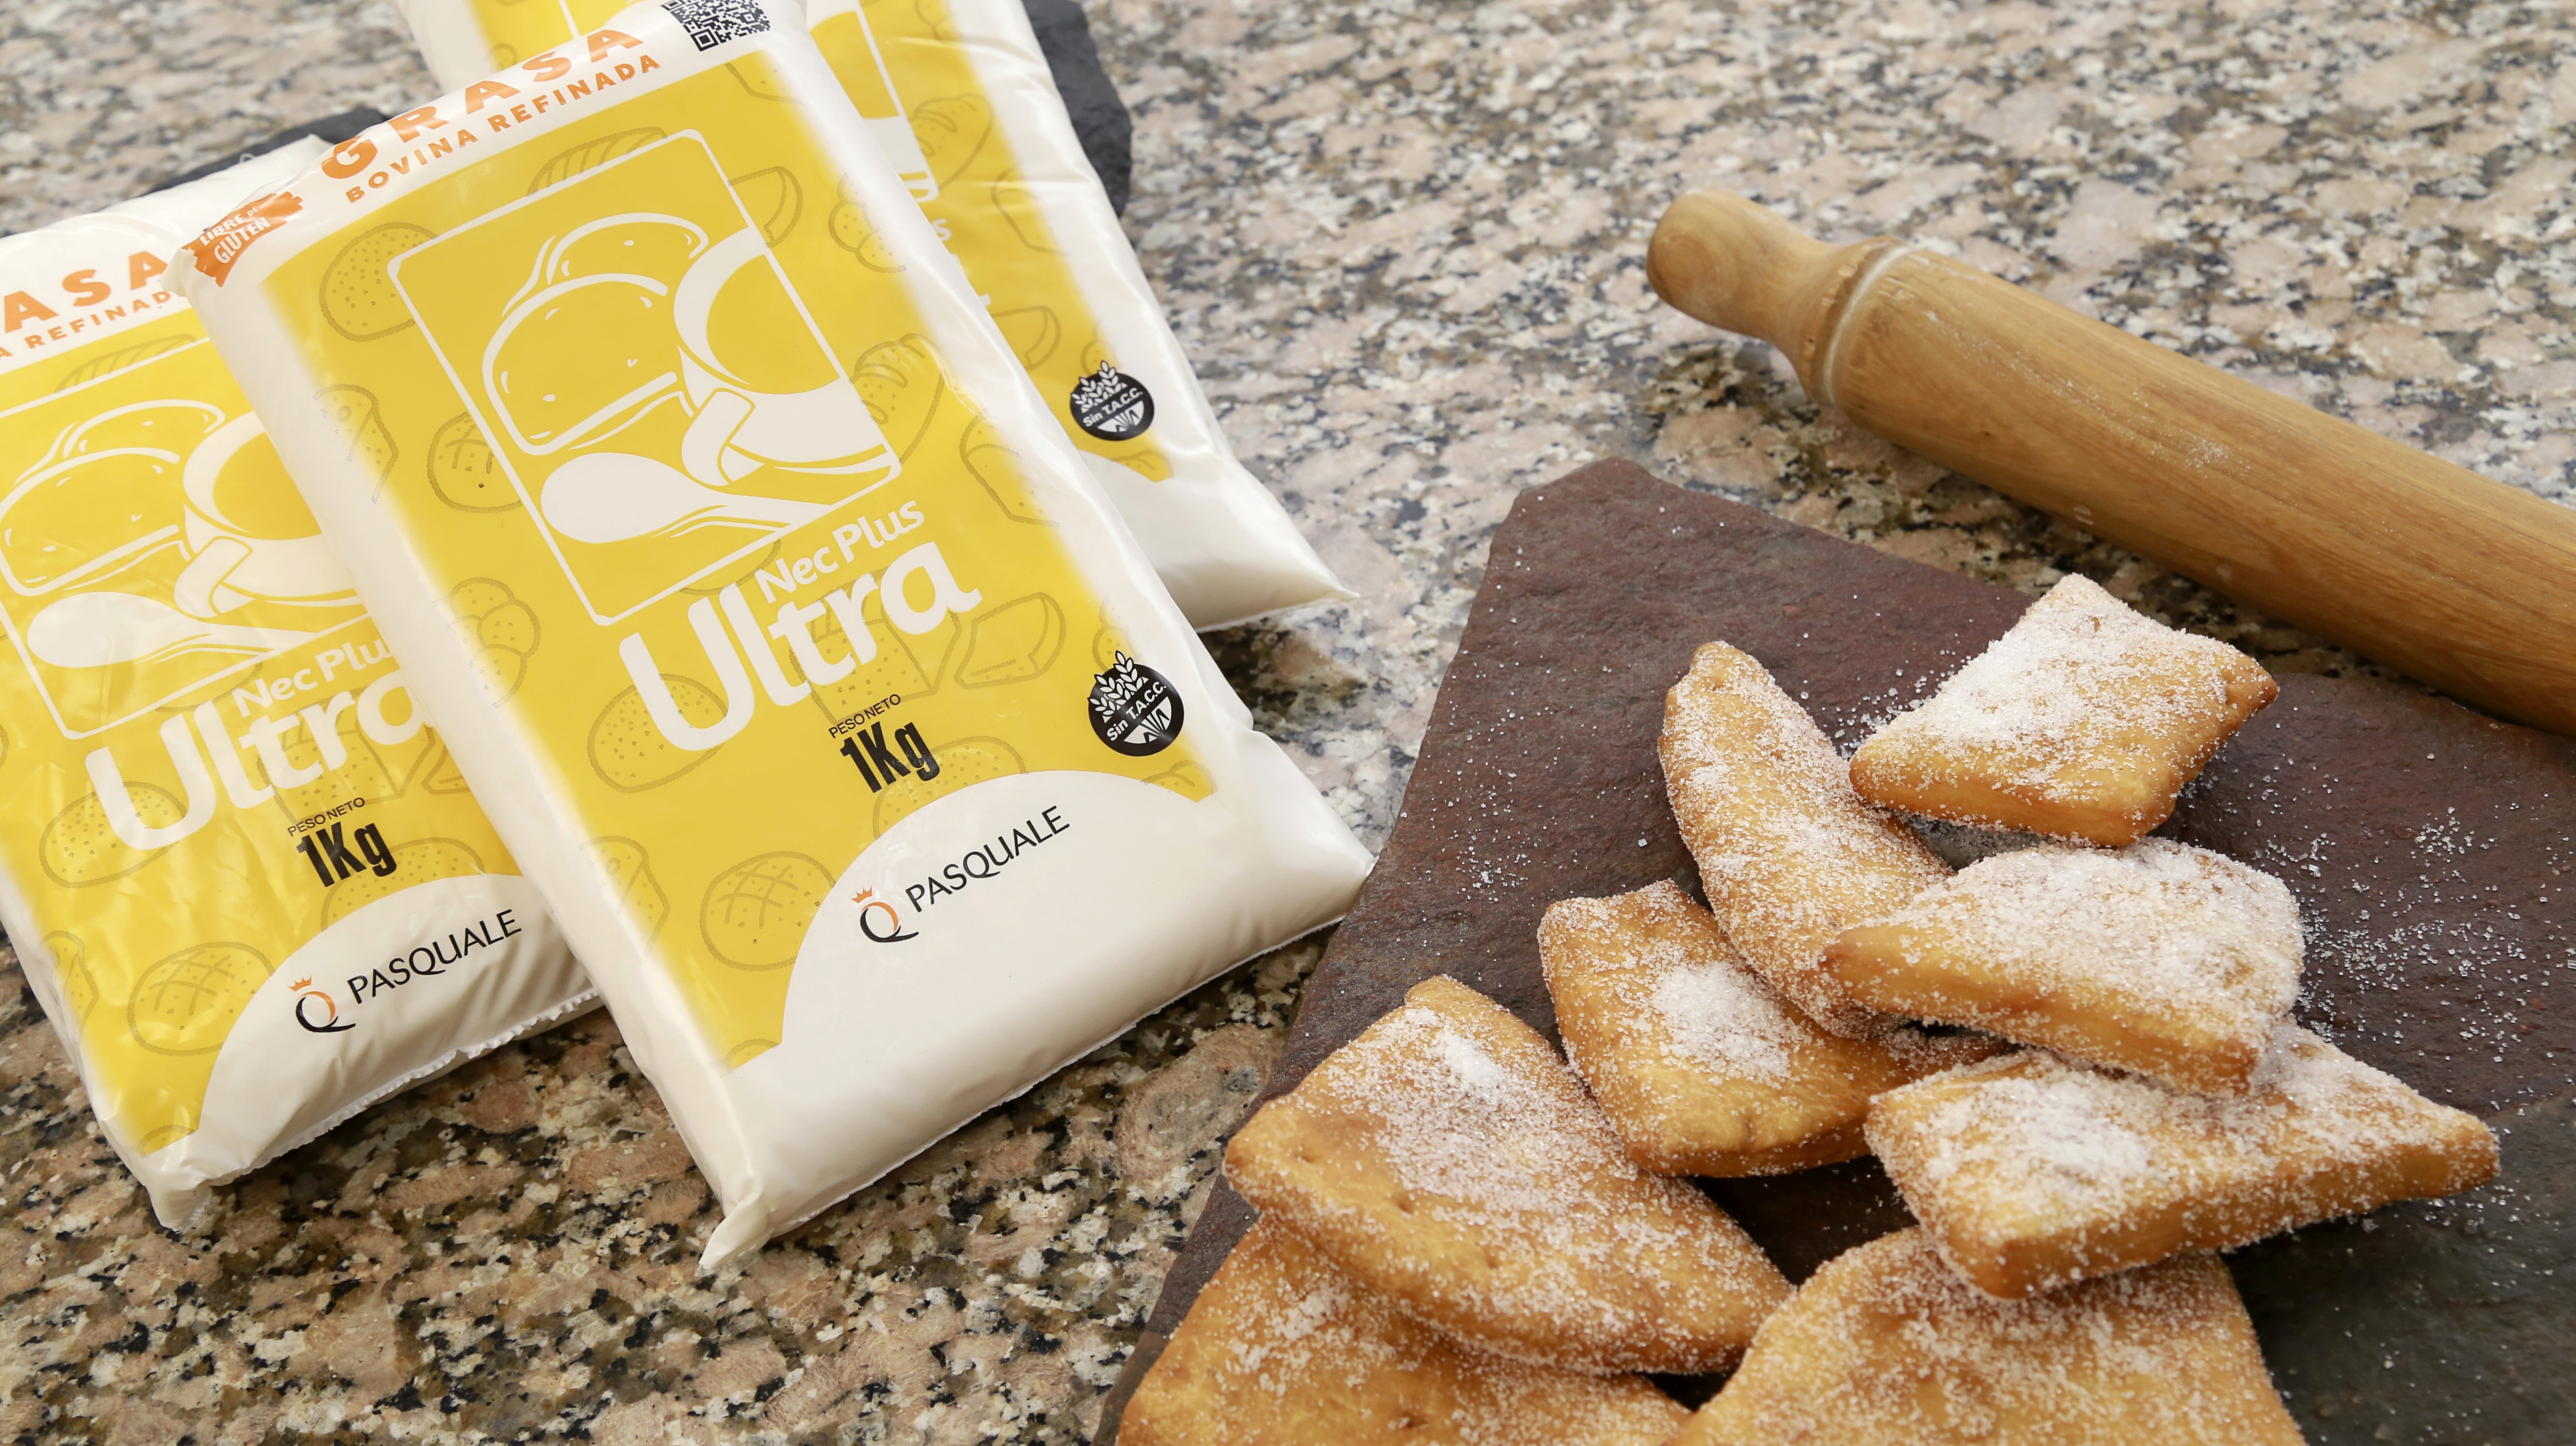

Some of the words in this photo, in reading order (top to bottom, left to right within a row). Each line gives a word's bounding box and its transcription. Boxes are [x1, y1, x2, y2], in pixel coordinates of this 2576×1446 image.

[321, 29, 644, 179] GRASA
[345, 129, 479, 203] BOVINA
[486, 55, 661, 133] REFINADA
[199, 214, 245, 246] LIBRE
[246, 206, 259, 217] DE
[214, 217, 271, 264] GLUTEN
[4, 251, 169, 334] ASA
[24, 291, 182, 349] REFINAD
[1083, 412, 1103, 427] Sin
[1101, 387, 1143, 415] T.A.C.C.
[753, 544, 840, 604] Nec
[832, 499, 925, 563] Plus
[232, 668, 318, 717] Nec
[315, 639, 394, 683] Plu
[619, 541, 983, 751] Ultra
[829, 713, 865, 739] PESO
[864, 694, 901, 720] NETO
[1107, 719, 1128, 741] Sin
[1126, 681, 1167, 720] T.A.C.C.
[84, 669, 435, 851] Ultra
[840, 721, 940, 793] 1Kg
[287, 814, 326, 837] PESO
[326, 797, 365, 820] NETO
[296, 821, 397, 887] 1Kg
[905, 805, 1070, 912] PASQUALE
[347, 909, 522, 1004] PASQUALE
